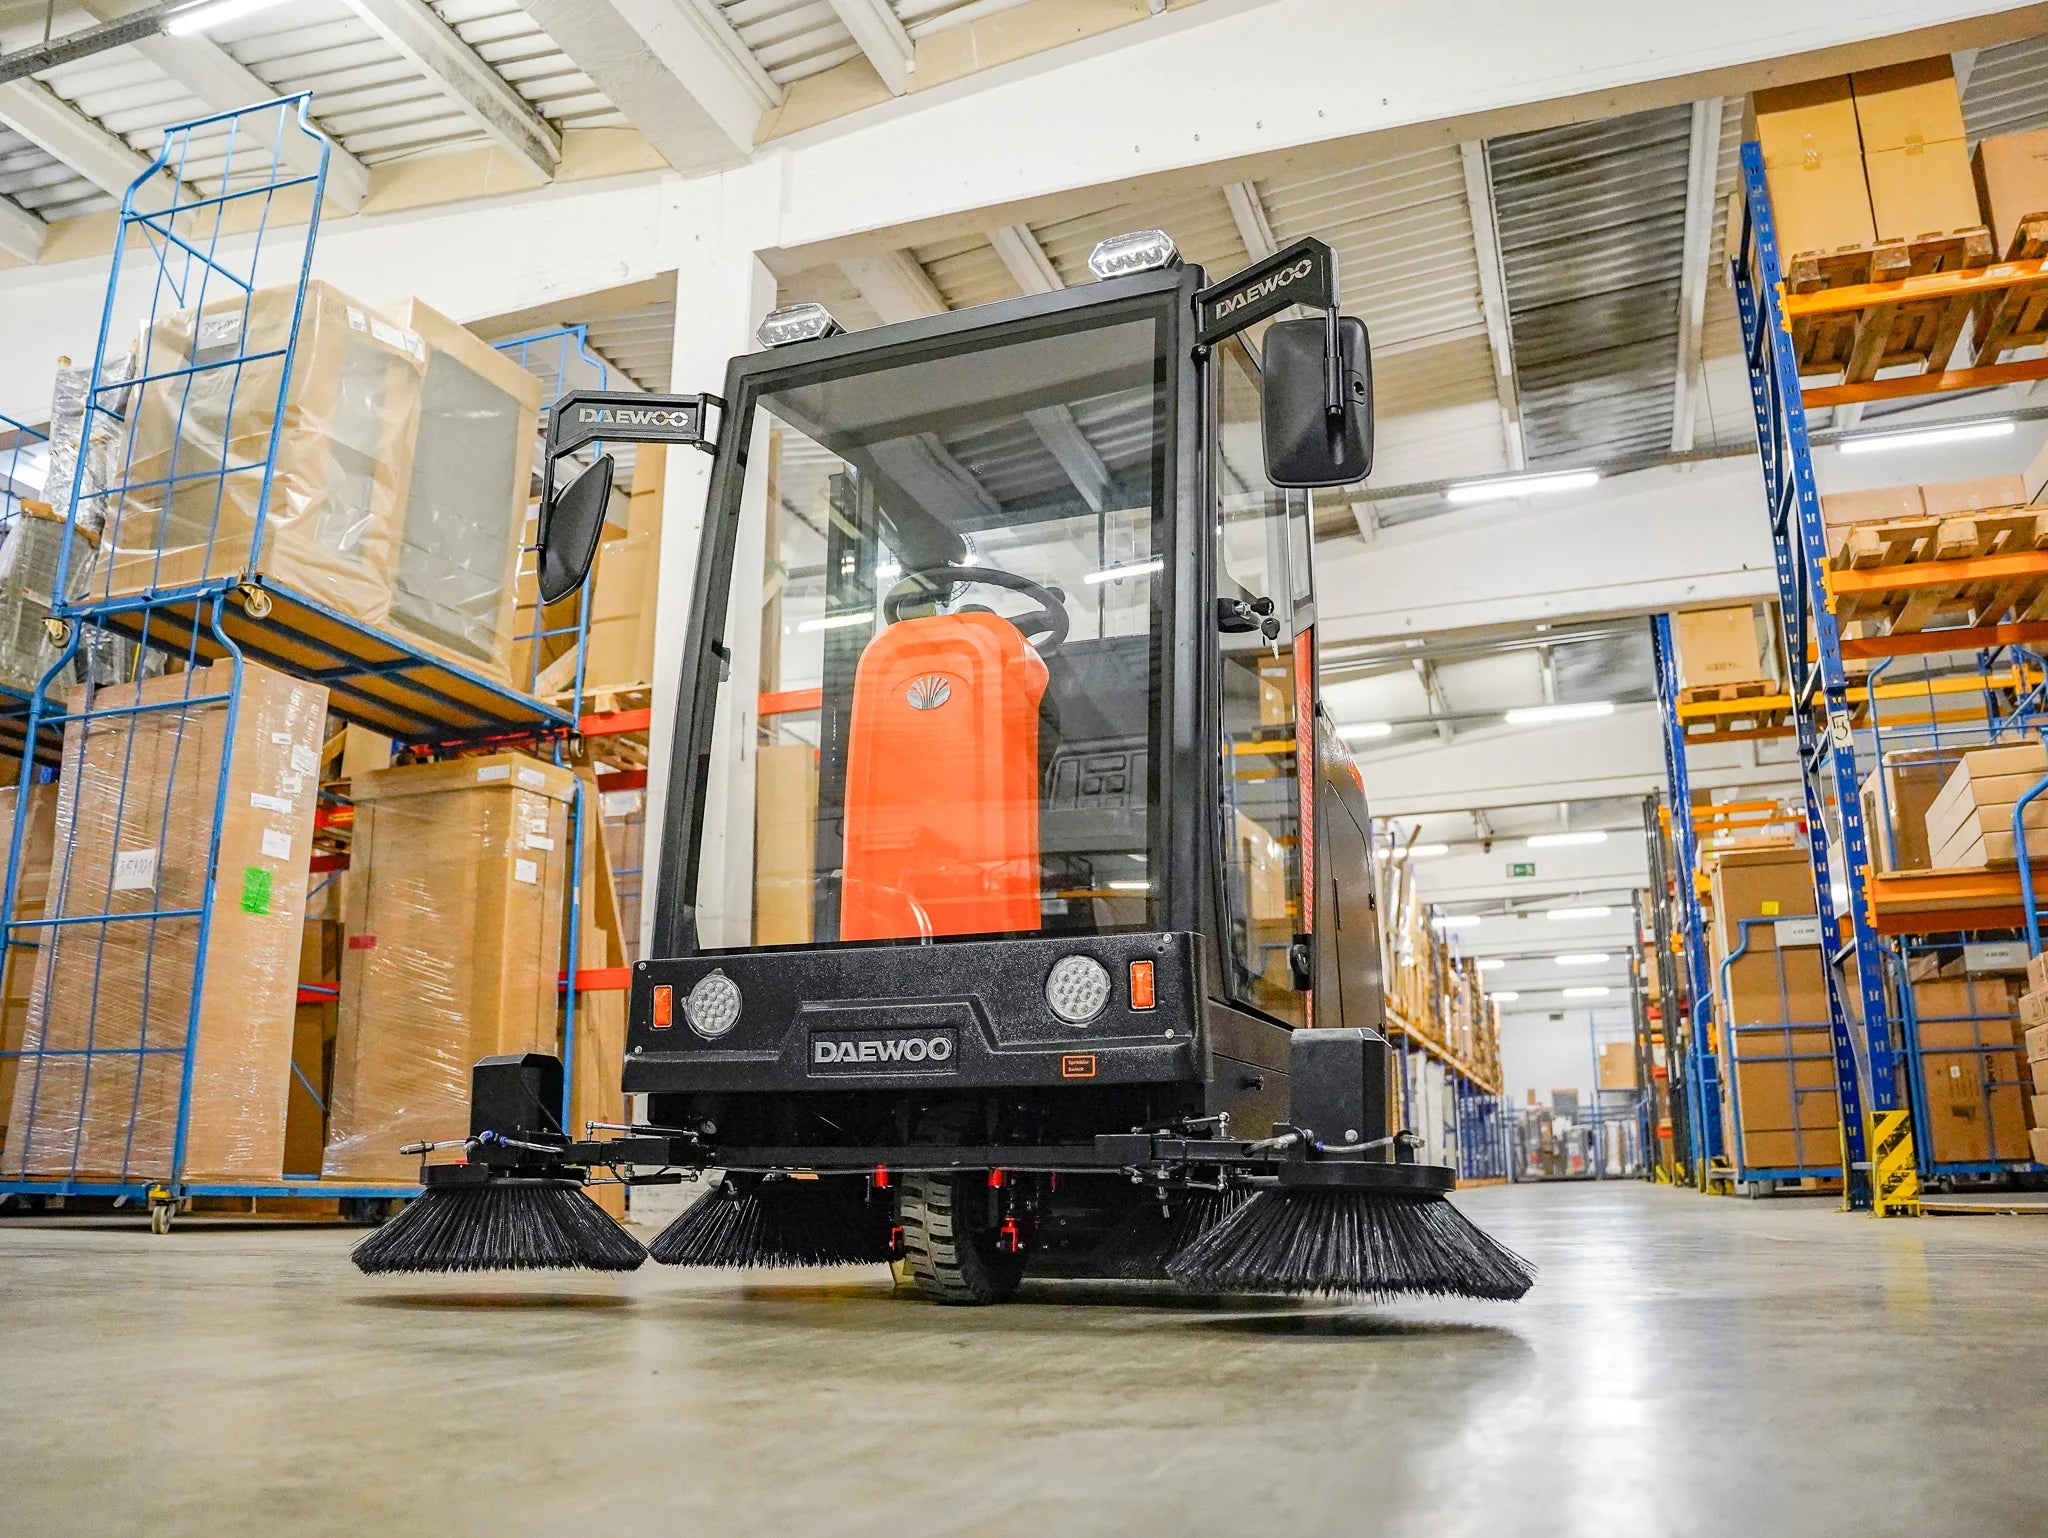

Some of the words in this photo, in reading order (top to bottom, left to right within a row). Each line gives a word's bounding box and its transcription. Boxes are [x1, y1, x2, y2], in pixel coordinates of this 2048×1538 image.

[1215, 259, 1312, 319] DAEWOO
[578, 408, 689, 427] DAEWOO
[1831, 714, 1848, 741] 5
[814, 1037, 952, 1063] DAEWOO
